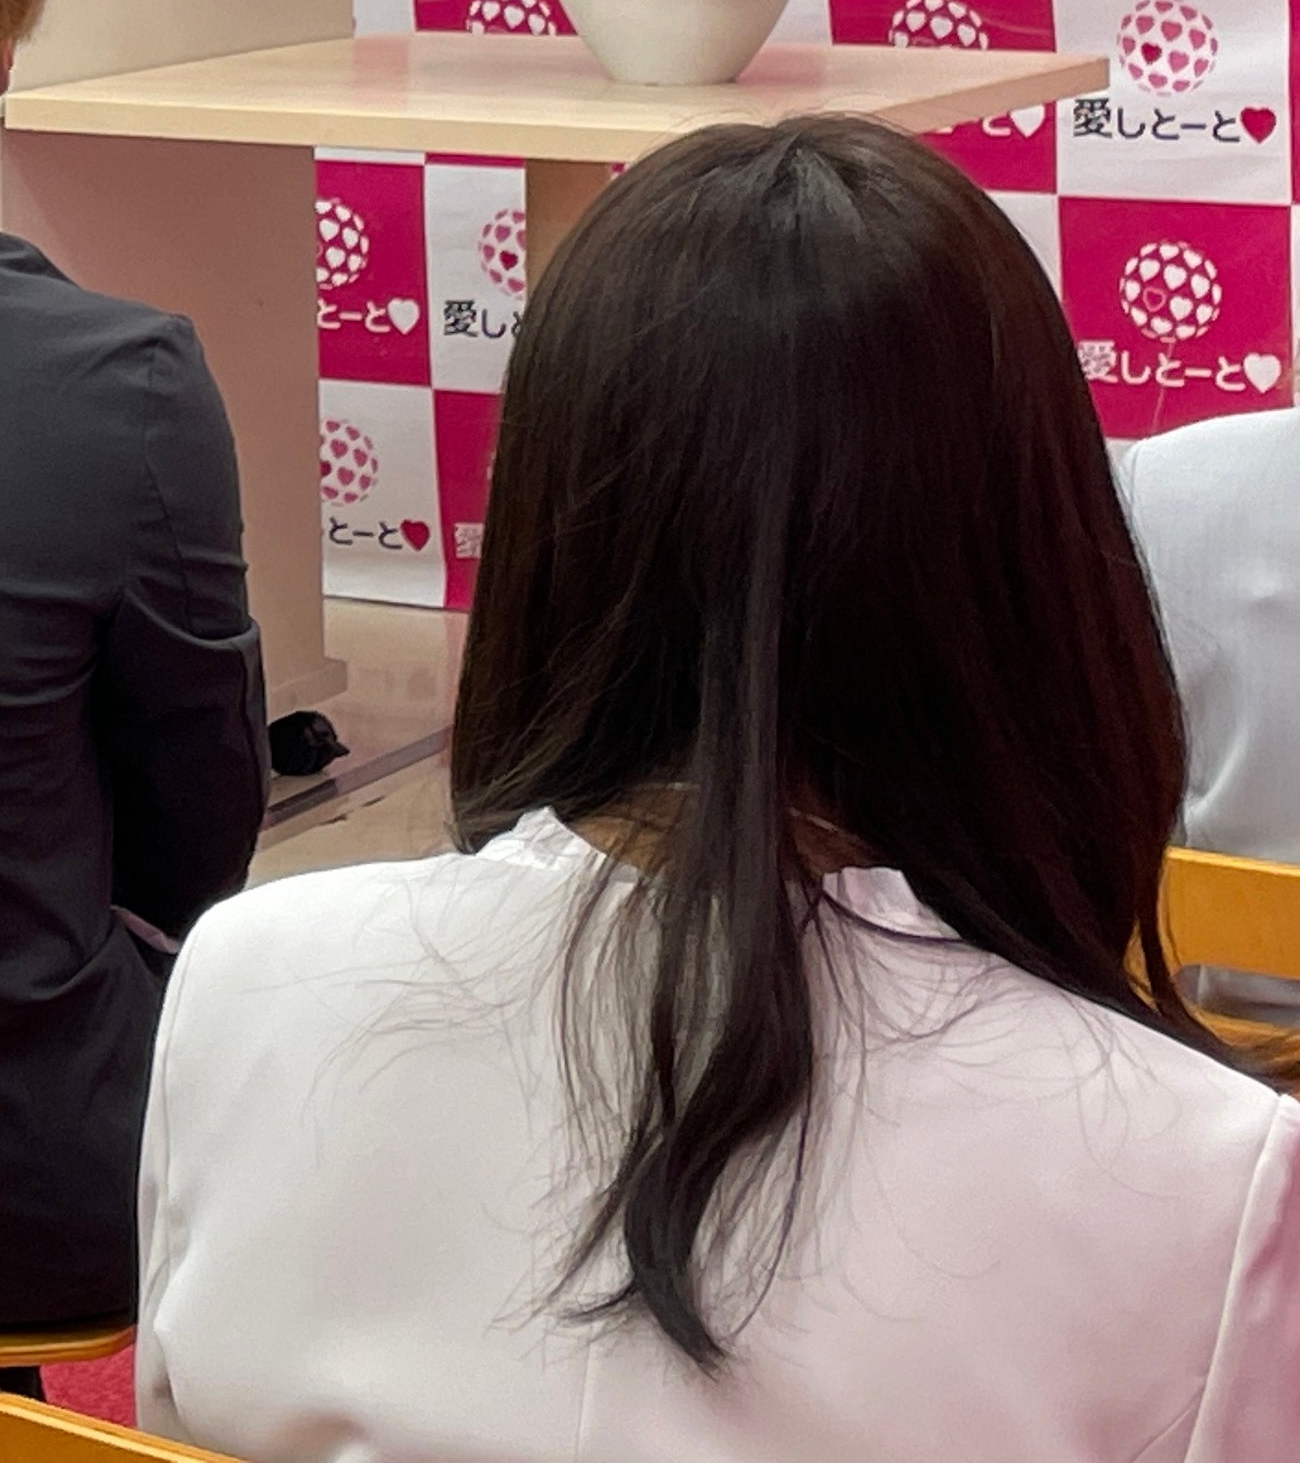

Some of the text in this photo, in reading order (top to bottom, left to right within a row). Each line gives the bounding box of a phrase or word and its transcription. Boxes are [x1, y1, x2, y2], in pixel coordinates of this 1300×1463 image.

[1073, 99, 1240, 142] 愛しとーと
[319, 299, 390, 333] とーと
[1078, 341, 1245, 391] 愛しとーと
[328, 517, 403, 549] とーと
